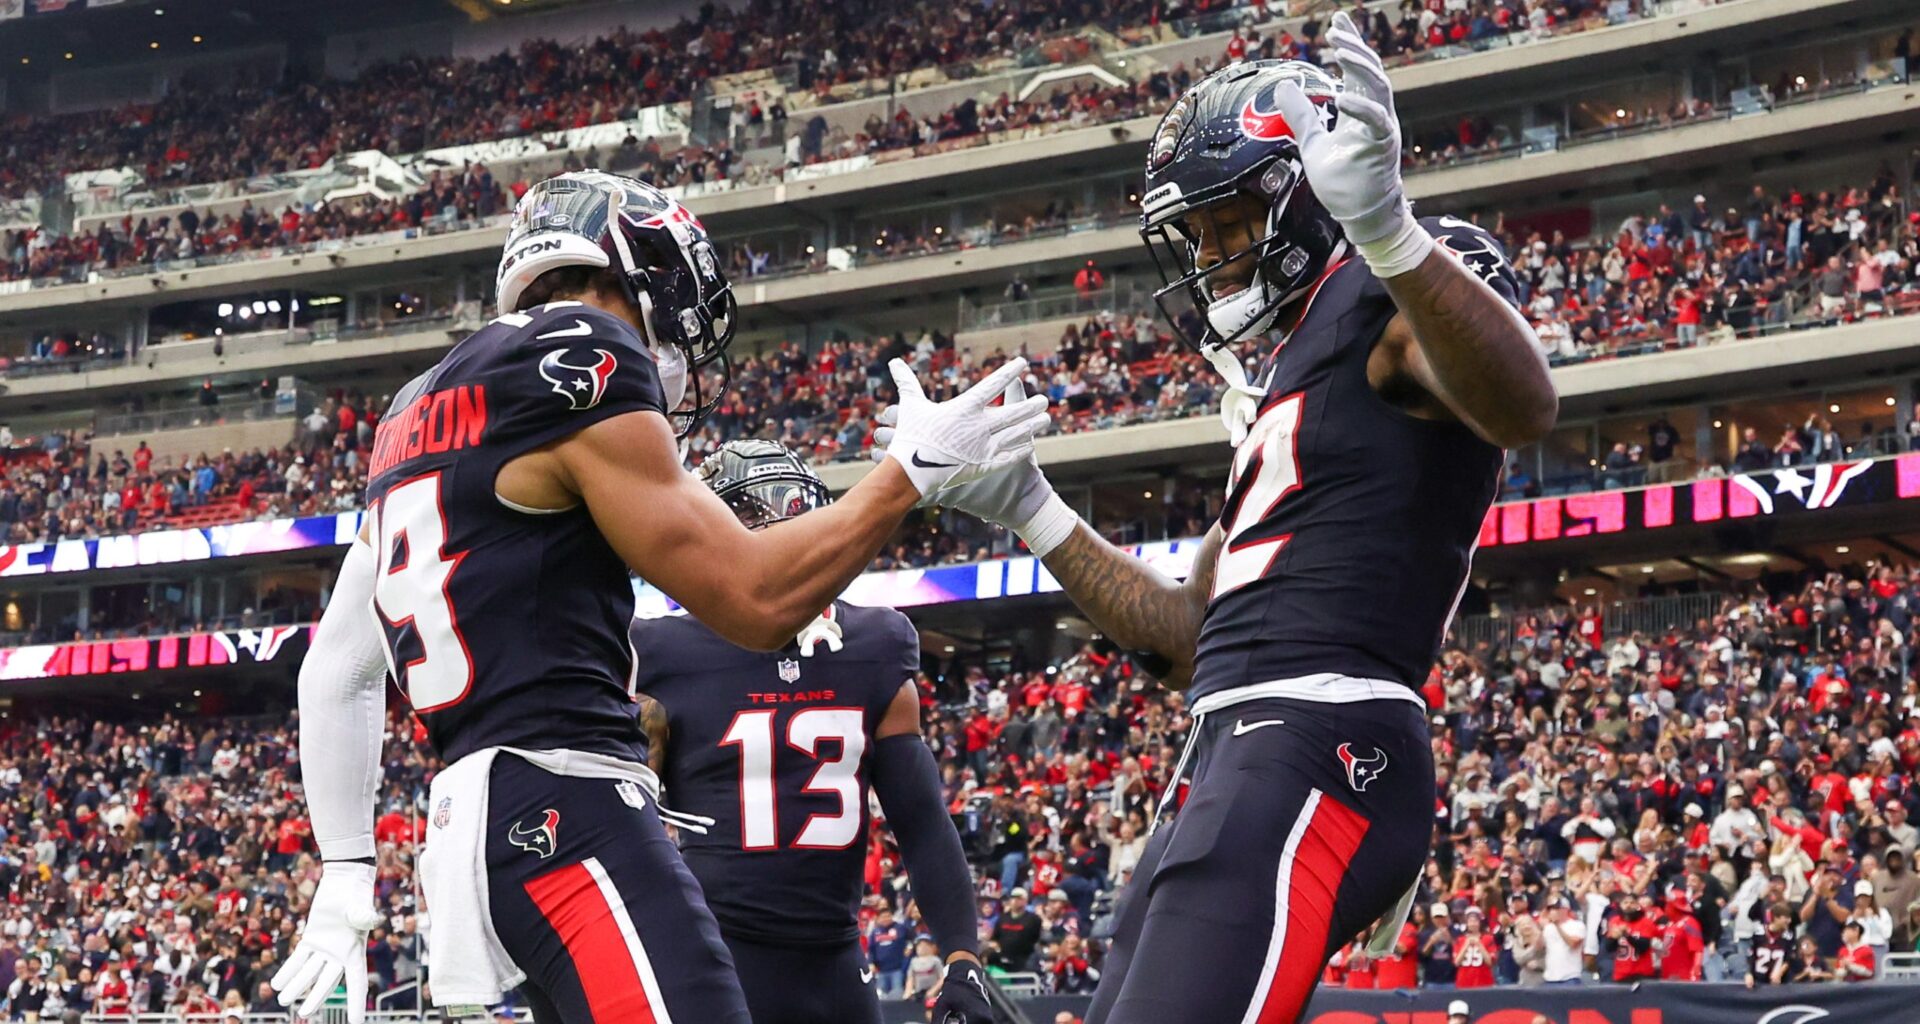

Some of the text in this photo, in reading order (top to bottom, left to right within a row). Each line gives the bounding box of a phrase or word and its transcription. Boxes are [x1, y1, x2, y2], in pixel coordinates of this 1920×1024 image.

[747, 690, 836, 704] TEXANS
[717, 706, 866, 851] 13
[1755, 947, 1785, 974] 27
